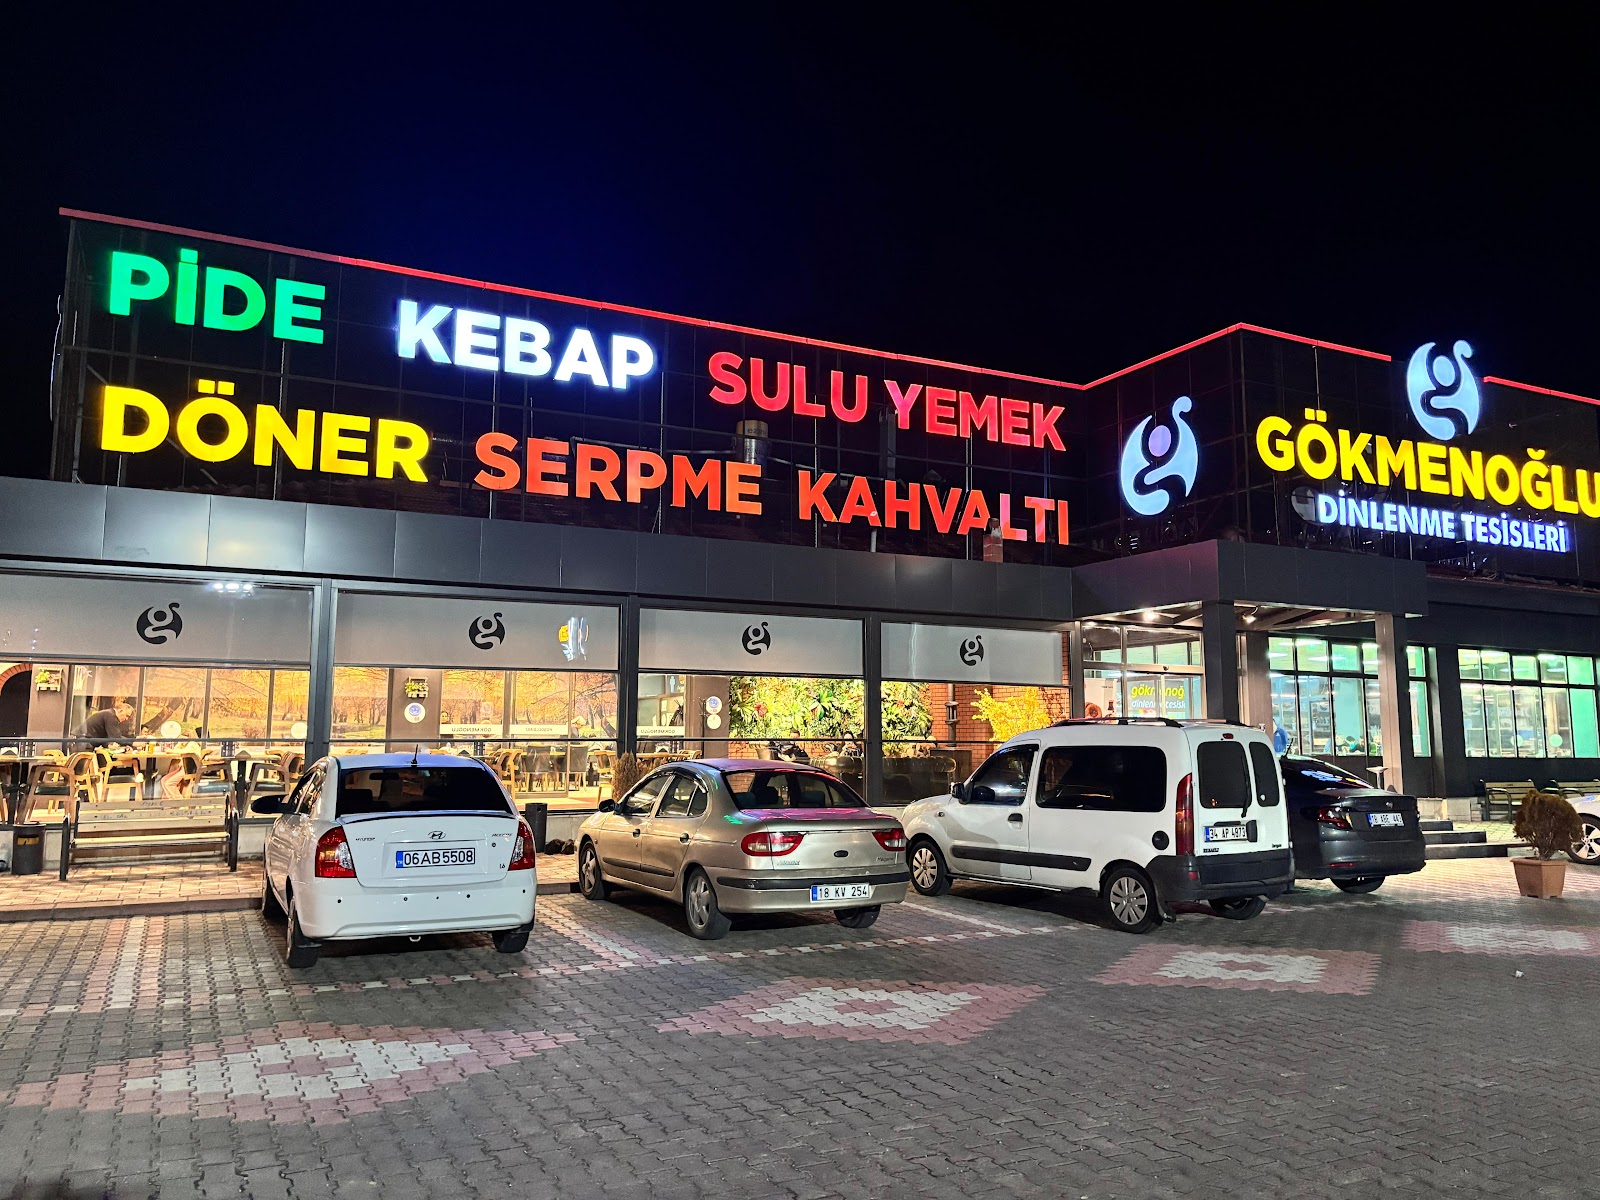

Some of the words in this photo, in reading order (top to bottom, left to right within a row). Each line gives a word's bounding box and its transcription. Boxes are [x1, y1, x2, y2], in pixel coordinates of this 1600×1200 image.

[109, 248, 326, 344] PİDE
[397, 299, 655, 389] KEBAP
[100, 379, 430, 483] DÖNER
[708, 352, 868, 422] SULU
[884, 379, 1066, 451] YEMEK
[474, 432, 763, 516] SERPME
[798, 470, 1069, 546] KAHVALTI
[1256, 407, 1600, 519] GÖKMENOĞLU
[1318, 489, 1456, 540] DİNLENME
[1461, 512, 1568, 554] TESİSLERİ
[1209, 828, 1218, 839] 34
[818, 887, 830, 898] 18
[835, 886, 846, 898] KV
[851, 885, 868, 897] 254
